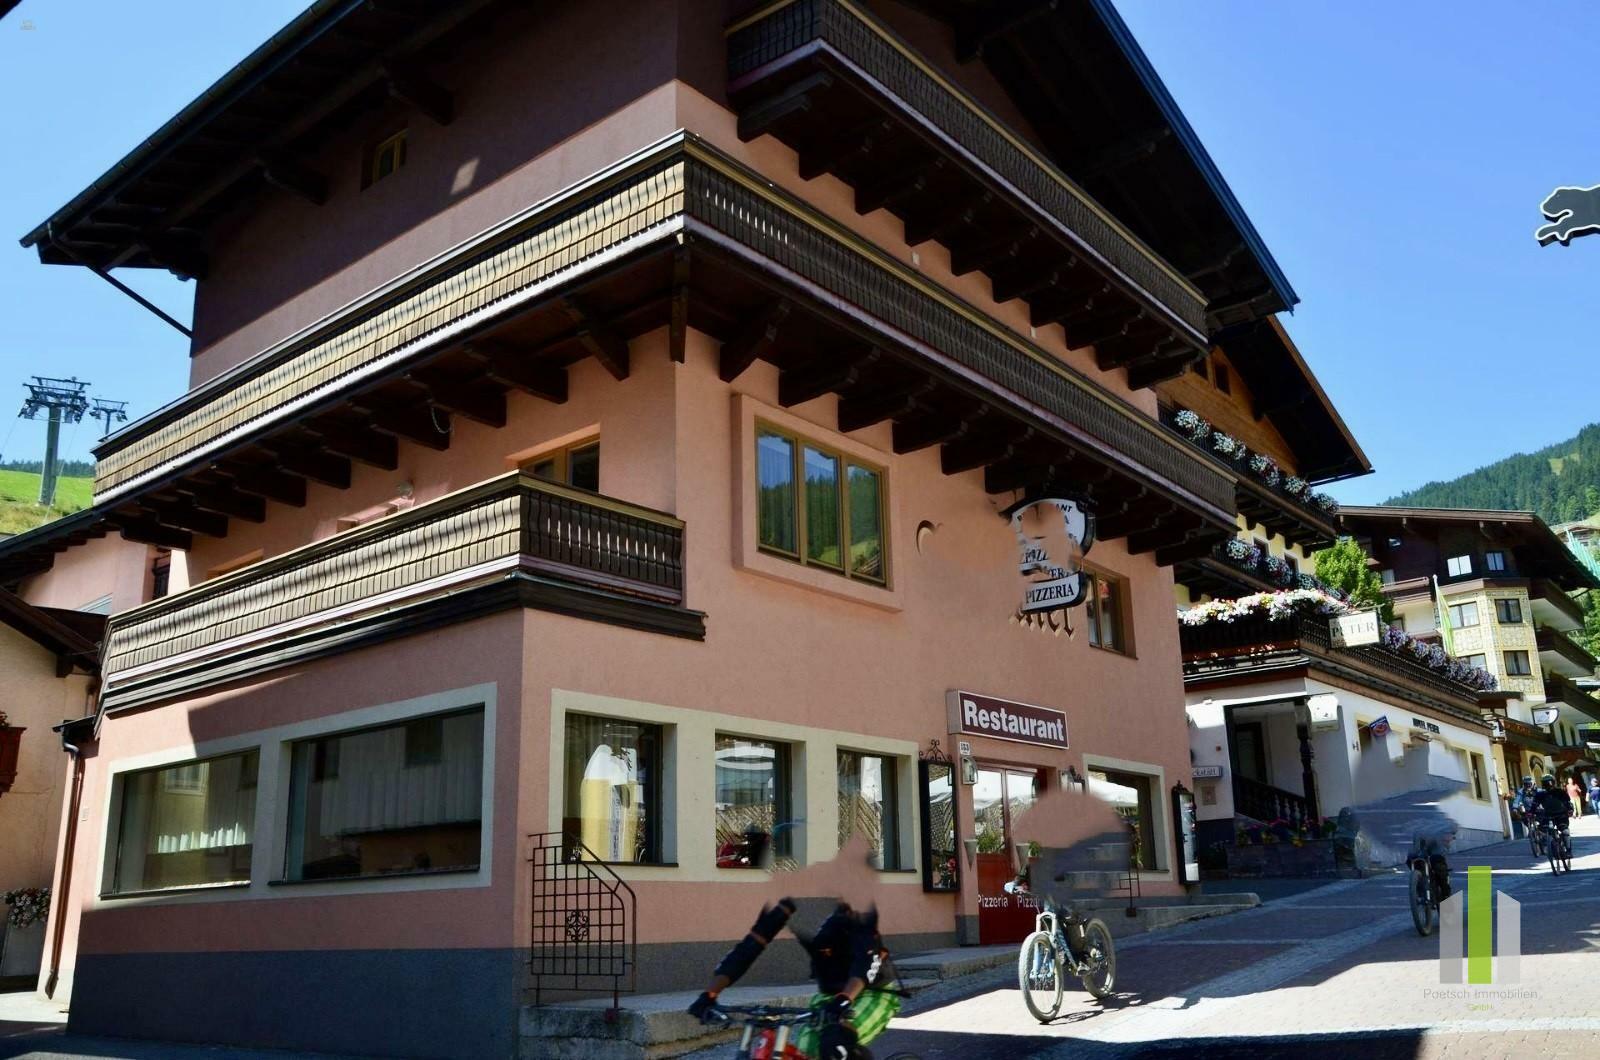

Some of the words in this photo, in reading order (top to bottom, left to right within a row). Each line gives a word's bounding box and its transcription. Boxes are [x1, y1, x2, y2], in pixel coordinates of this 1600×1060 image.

[1025, 583, 1075, 604] PIZZERIA
[963, 699, 1065, 742] Restaurant
[977, 894, 1009, 908] Pizzeria
